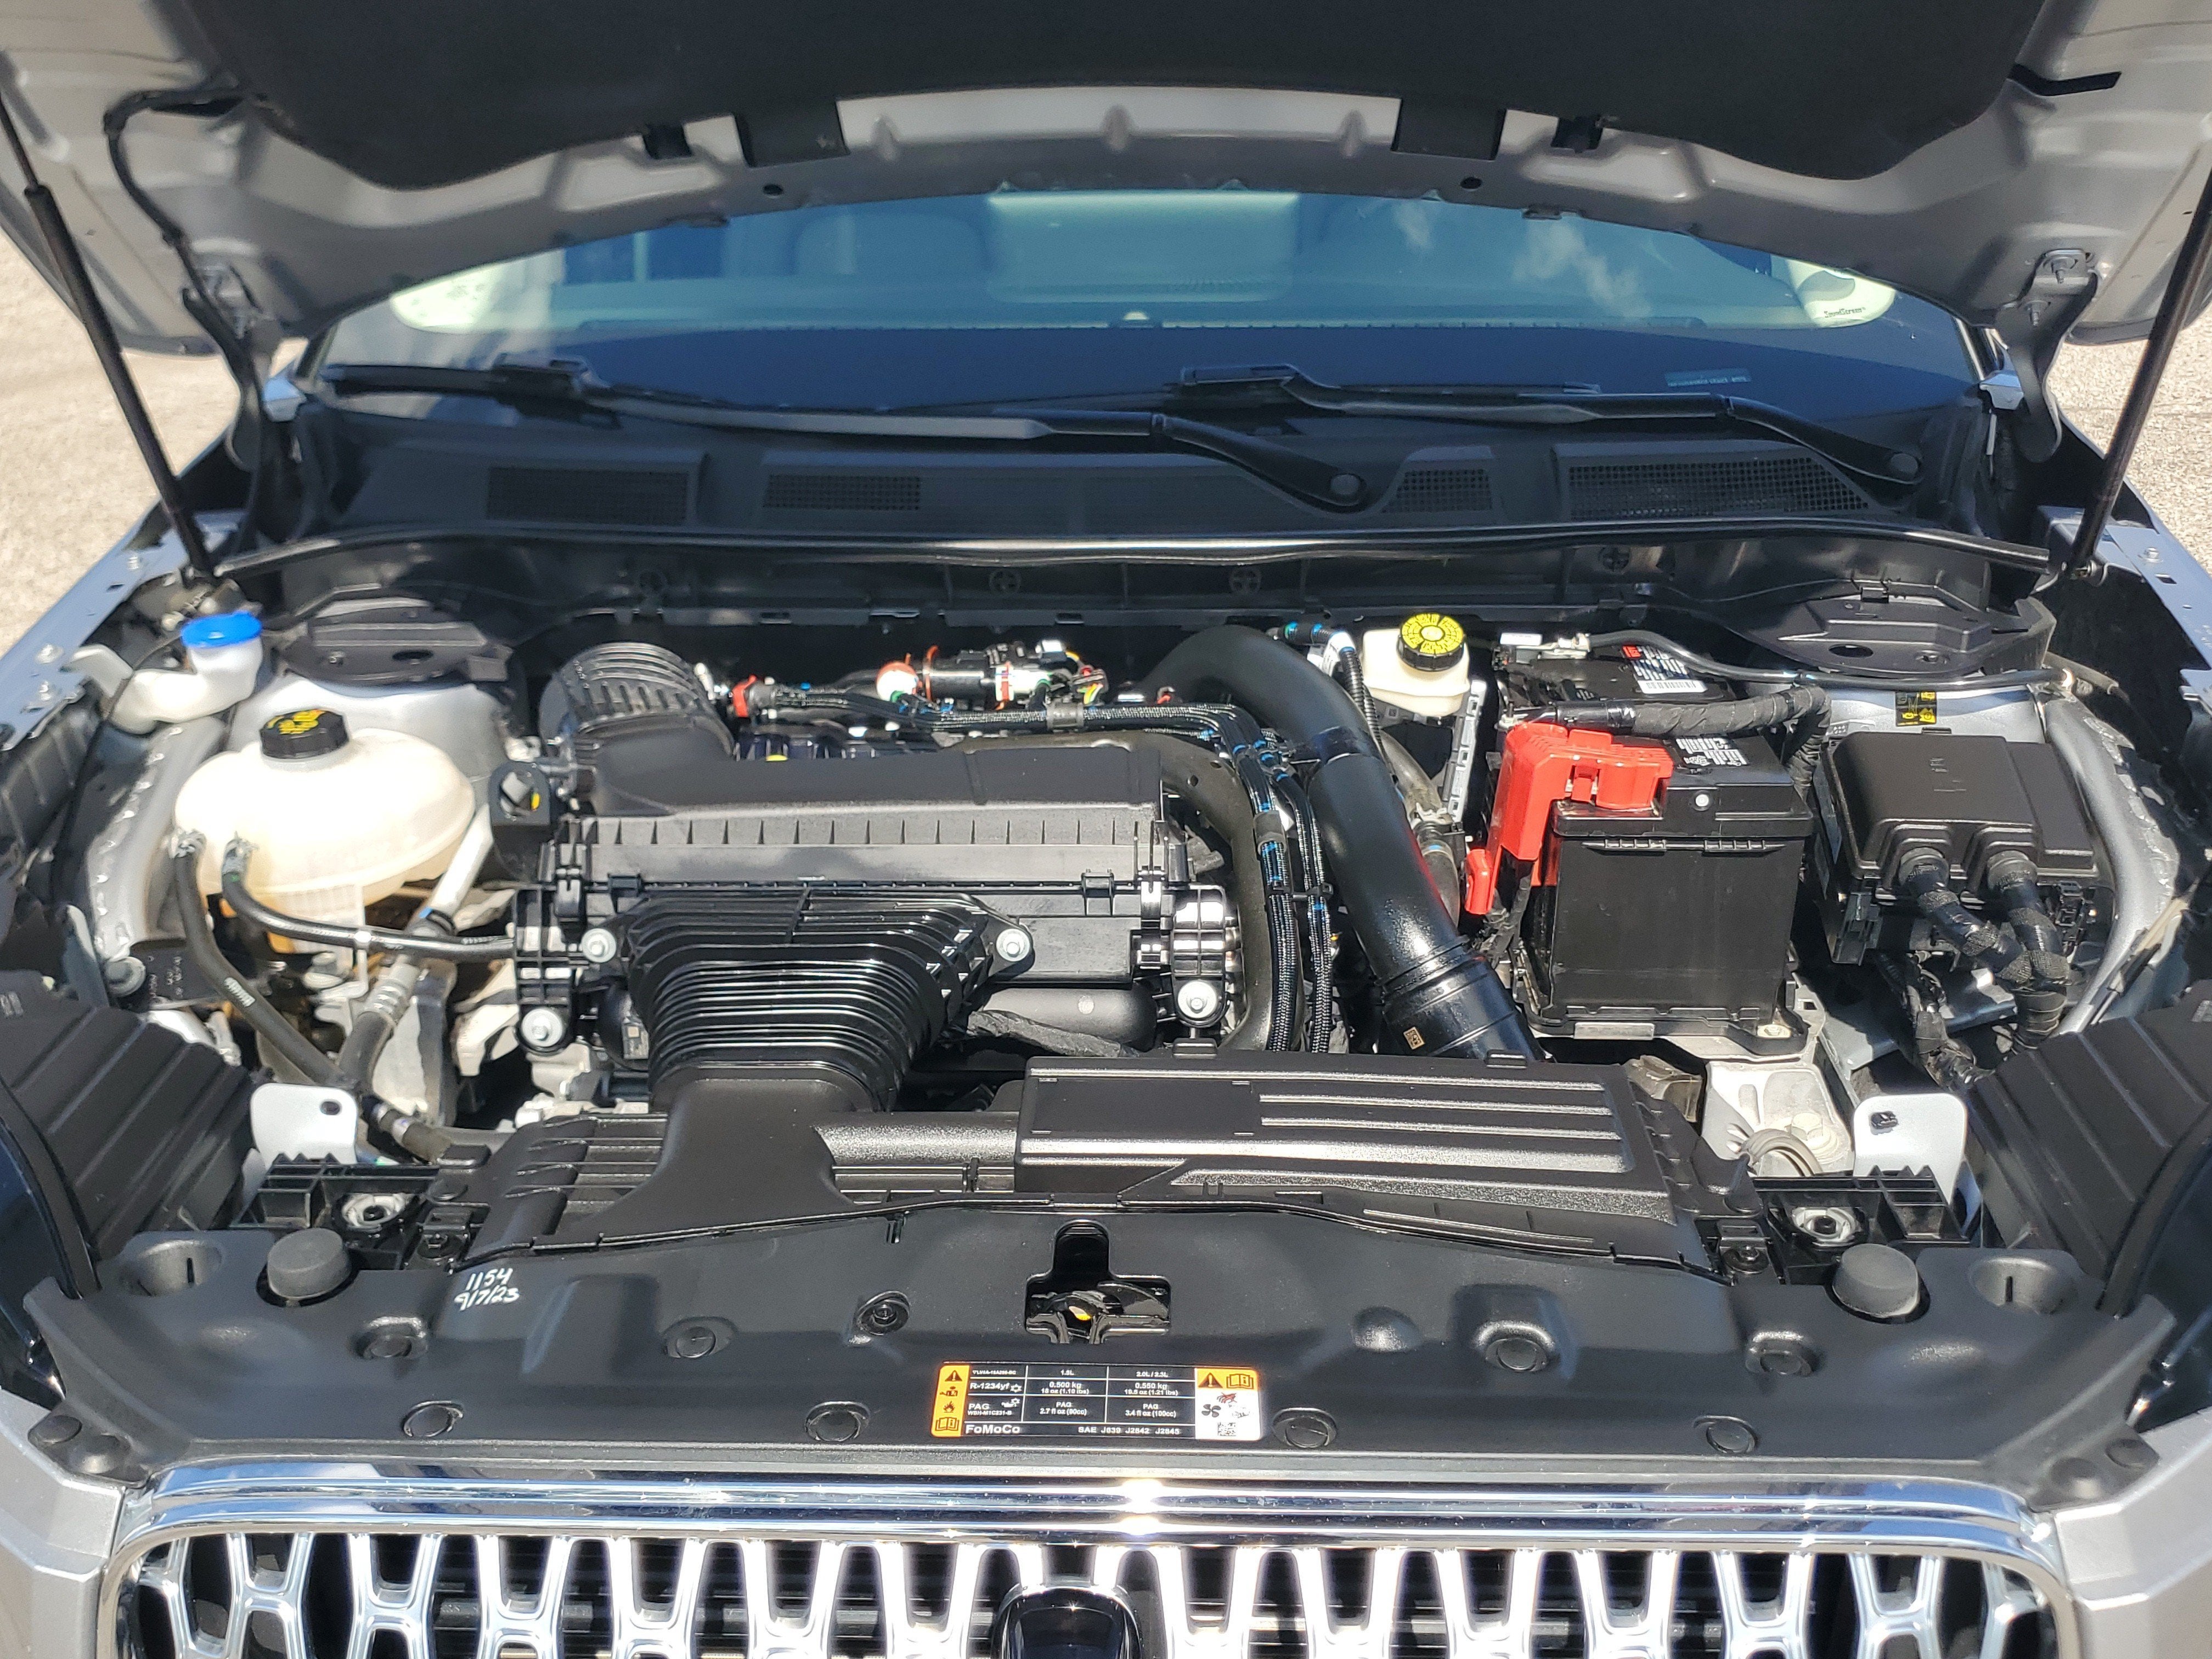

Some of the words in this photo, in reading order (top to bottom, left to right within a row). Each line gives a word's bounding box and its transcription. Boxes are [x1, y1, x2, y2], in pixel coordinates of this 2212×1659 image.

[465, 1267, 514, 1291] 1154
[969, 1383, 1010, 1391] R-1234yf
[965, 1425, 1020, 1434] FoMoCo
